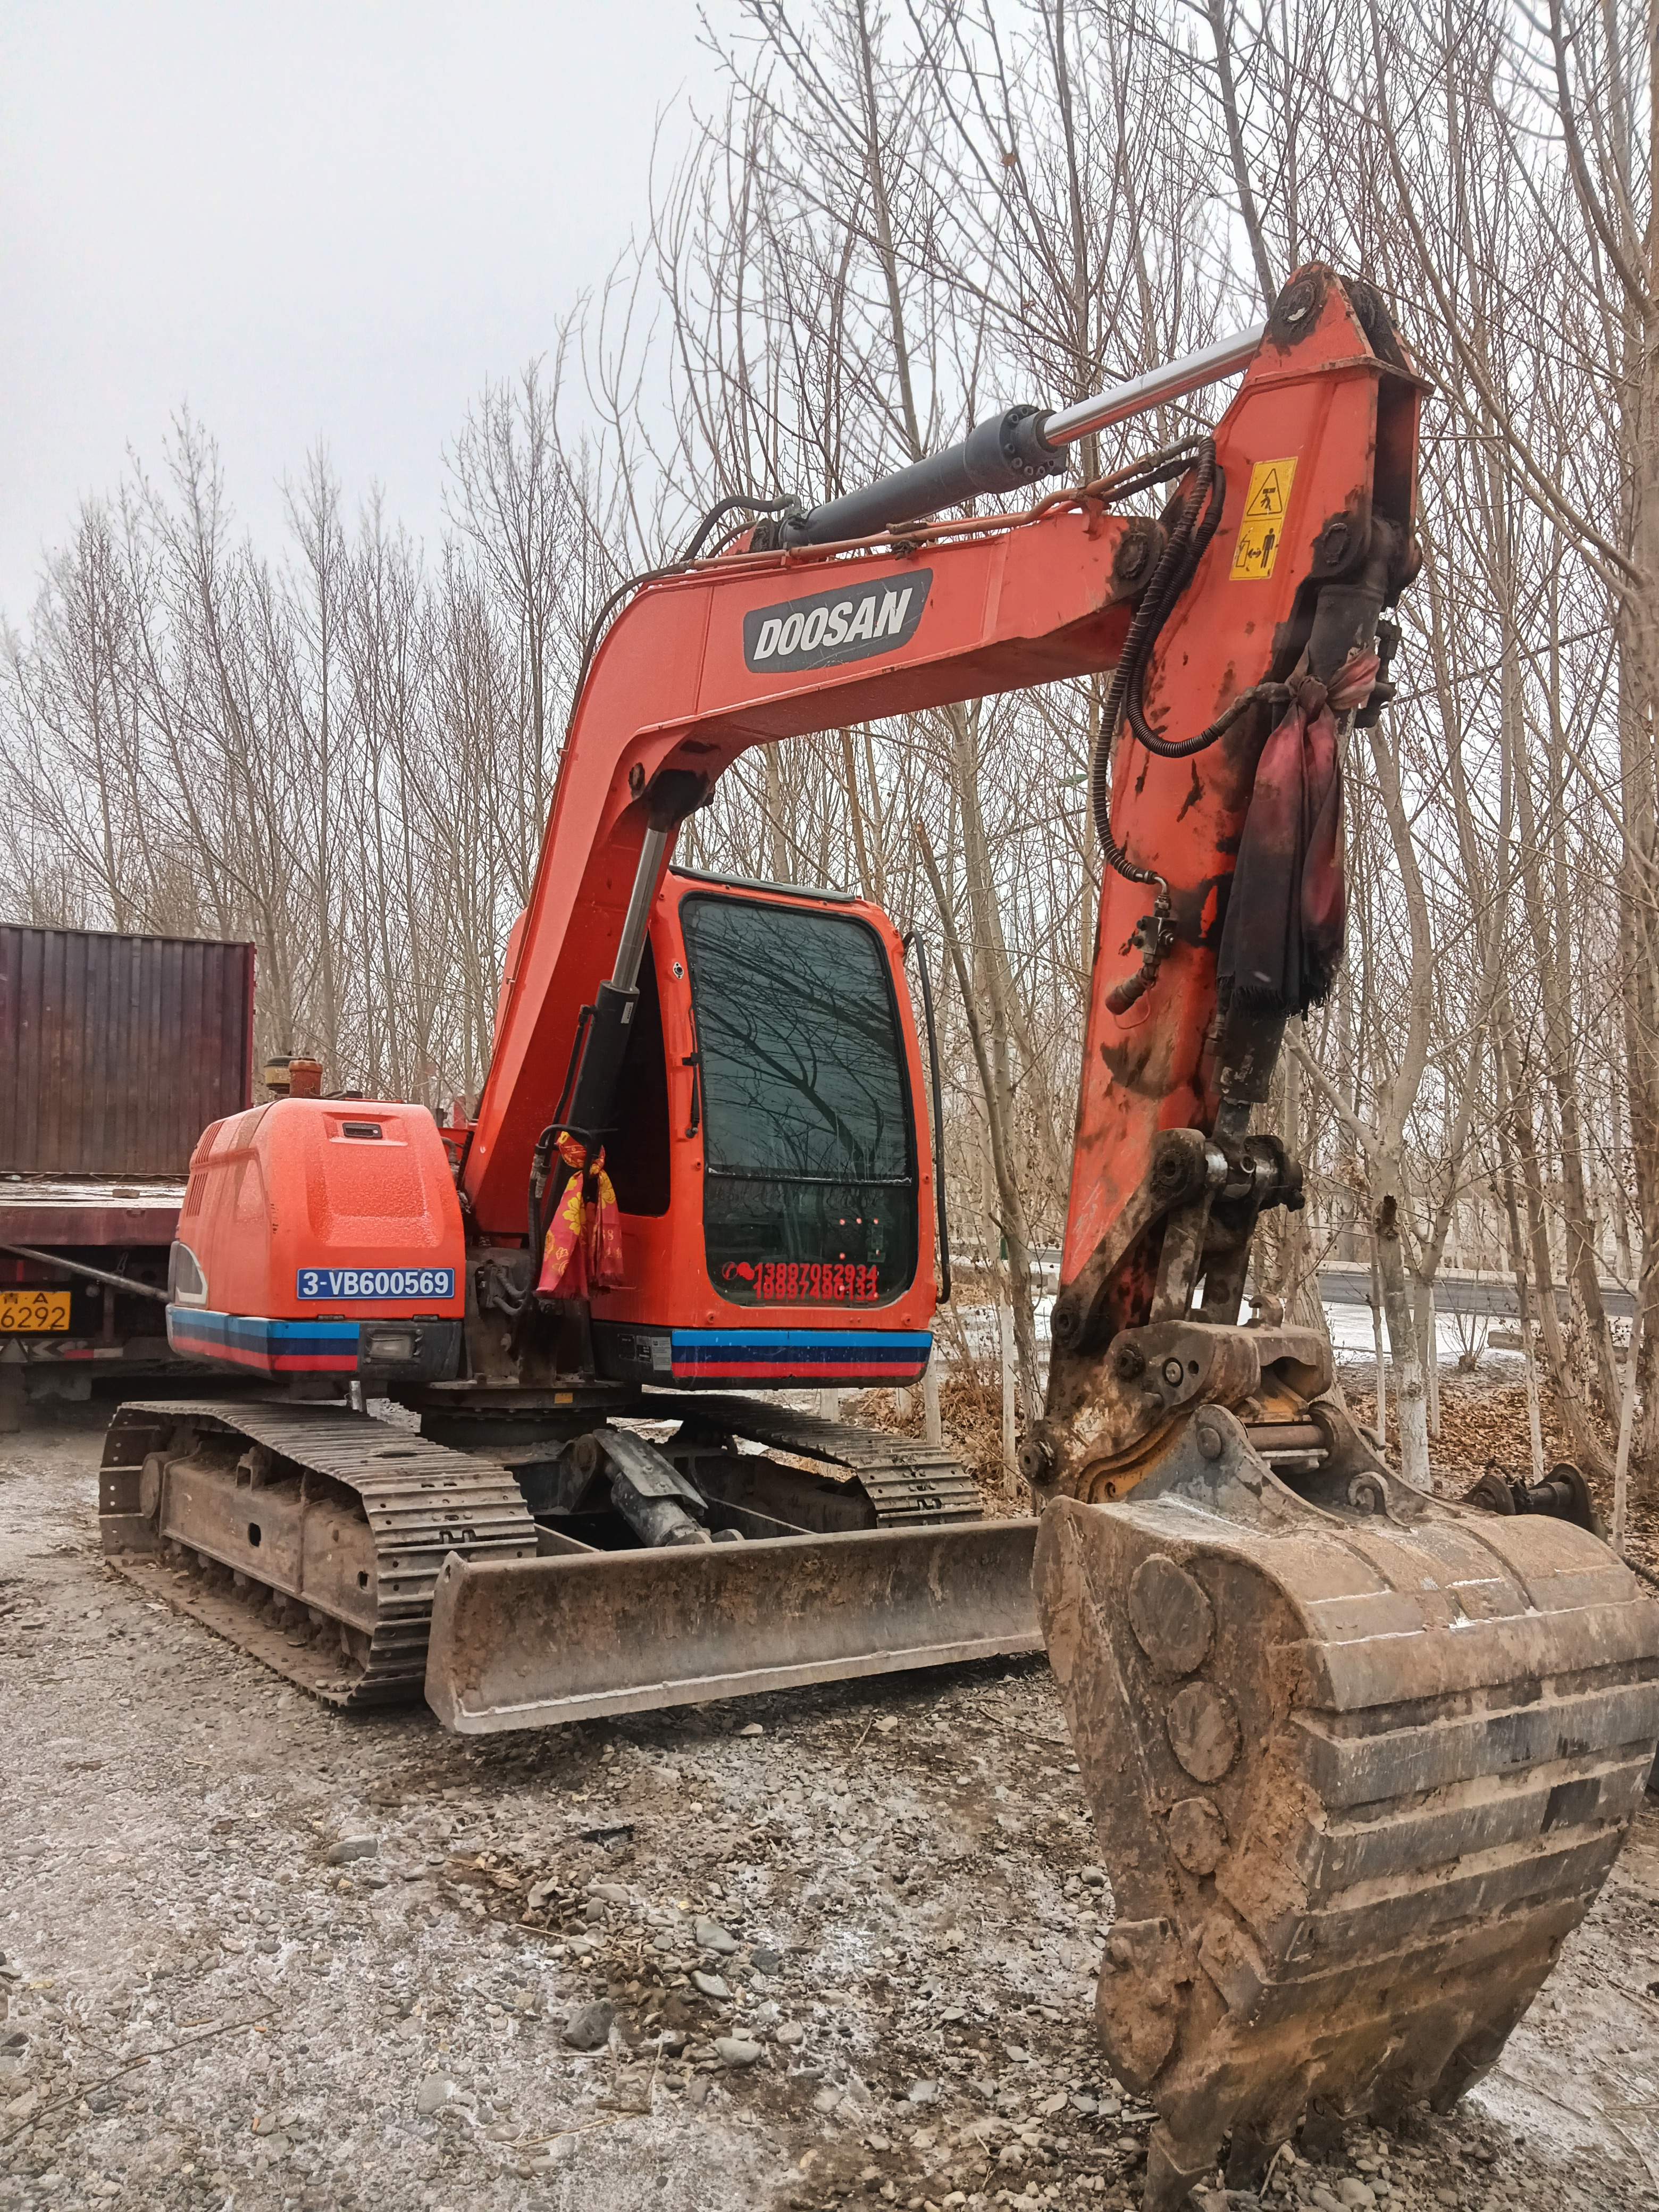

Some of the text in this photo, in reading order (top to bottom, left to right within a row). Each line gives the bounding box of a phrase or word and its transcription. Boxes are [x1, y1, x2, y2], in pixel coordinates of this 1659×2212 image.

[753, 587, 913, 660] DOOSAN
[303, 1271, 449, 1295] 3-VB600569
[1, 1306, 65, 1328] 6292
